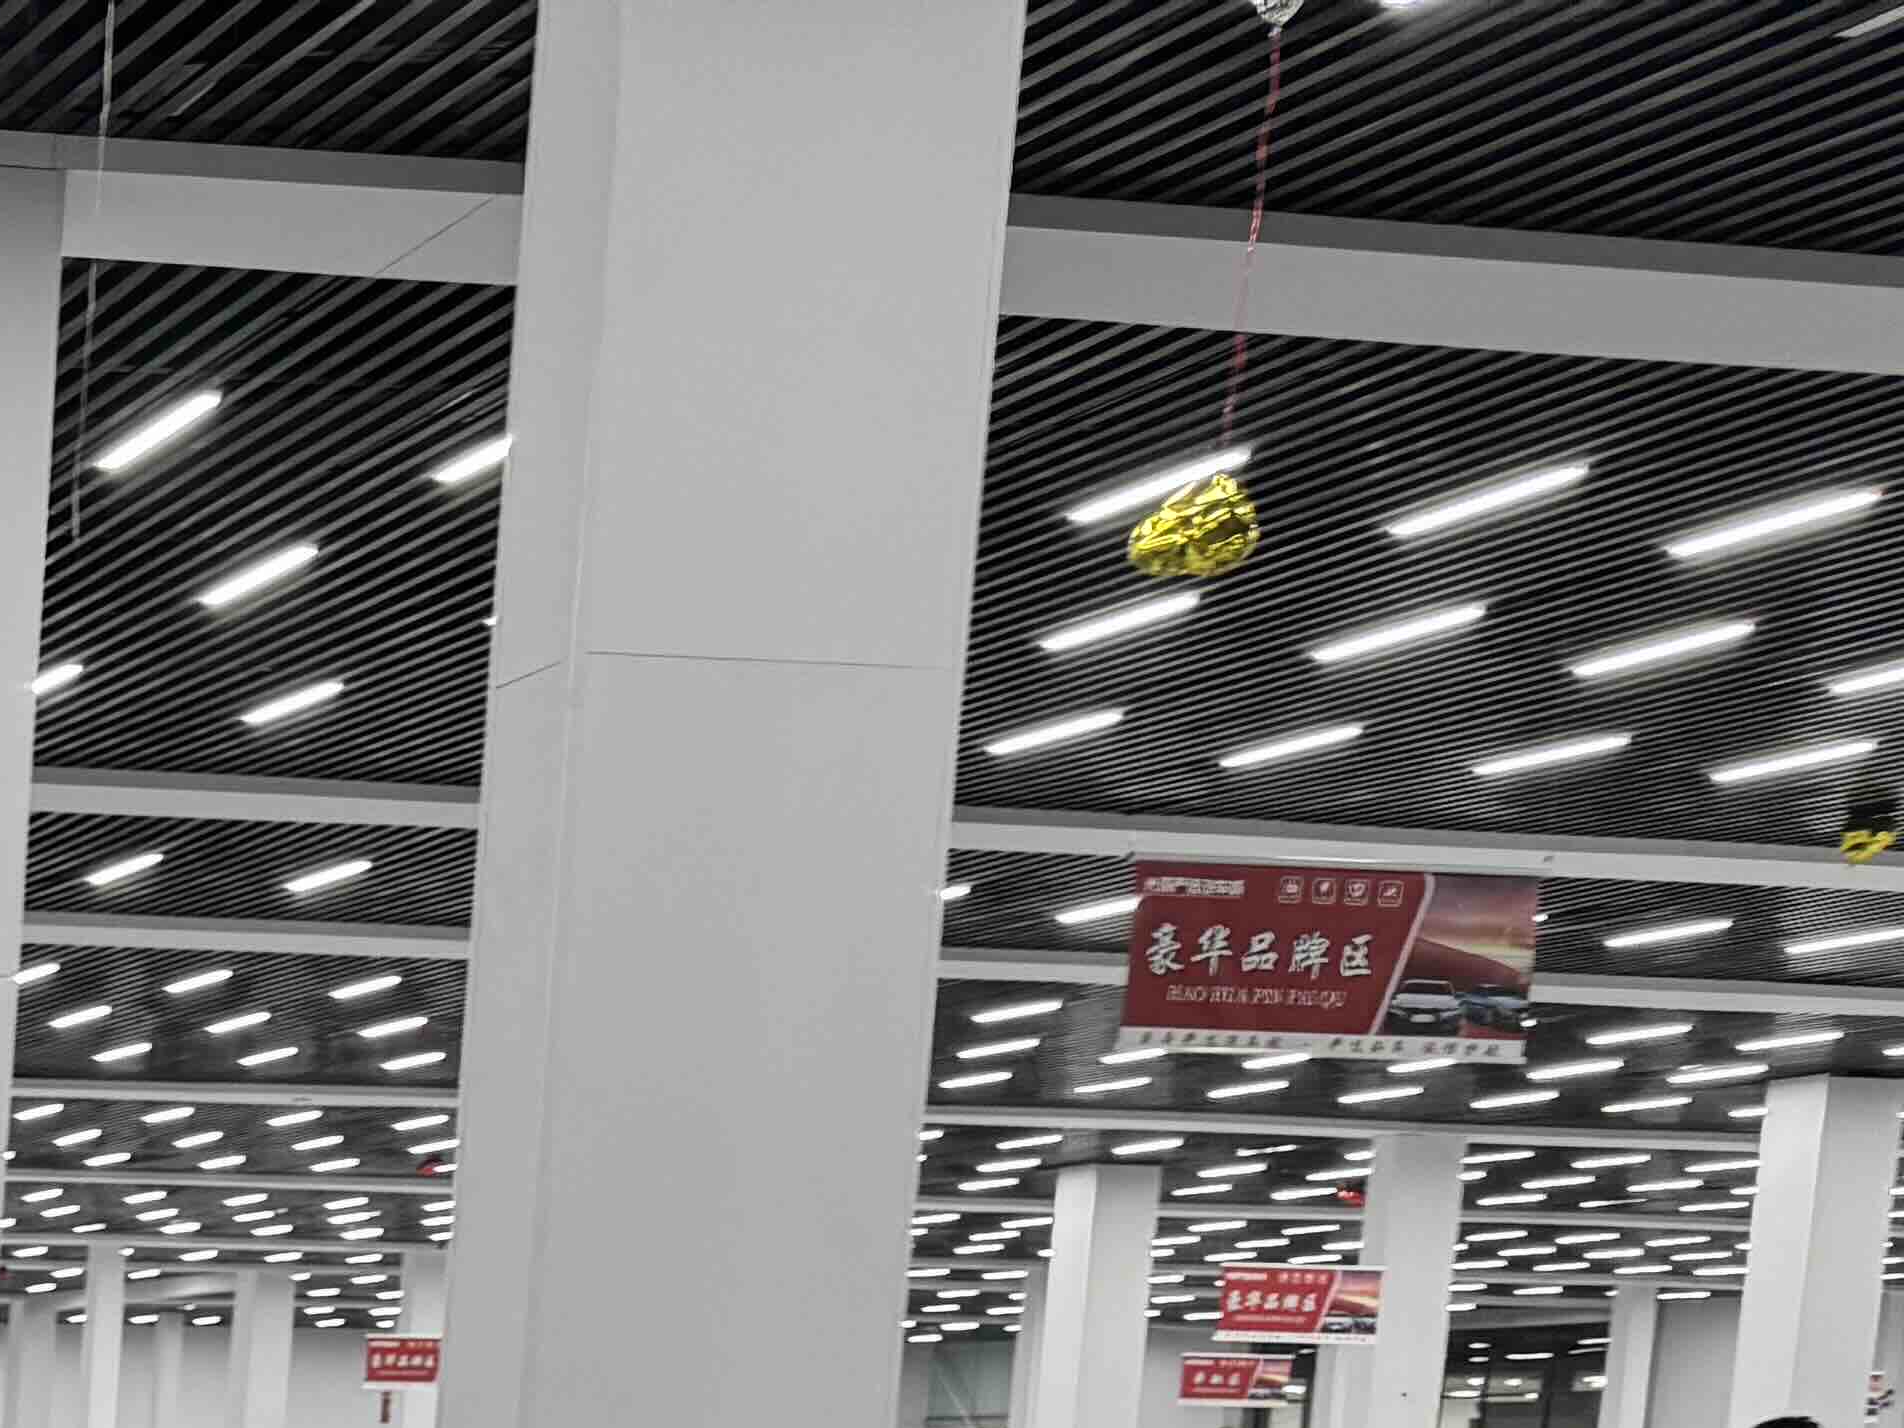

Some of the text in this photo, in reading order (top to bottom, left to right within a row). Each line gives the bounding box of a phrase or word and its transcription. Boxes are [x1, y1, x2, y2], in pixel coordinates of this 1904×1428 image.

[1145, 922, 1374, 980] 豪华品牌区
